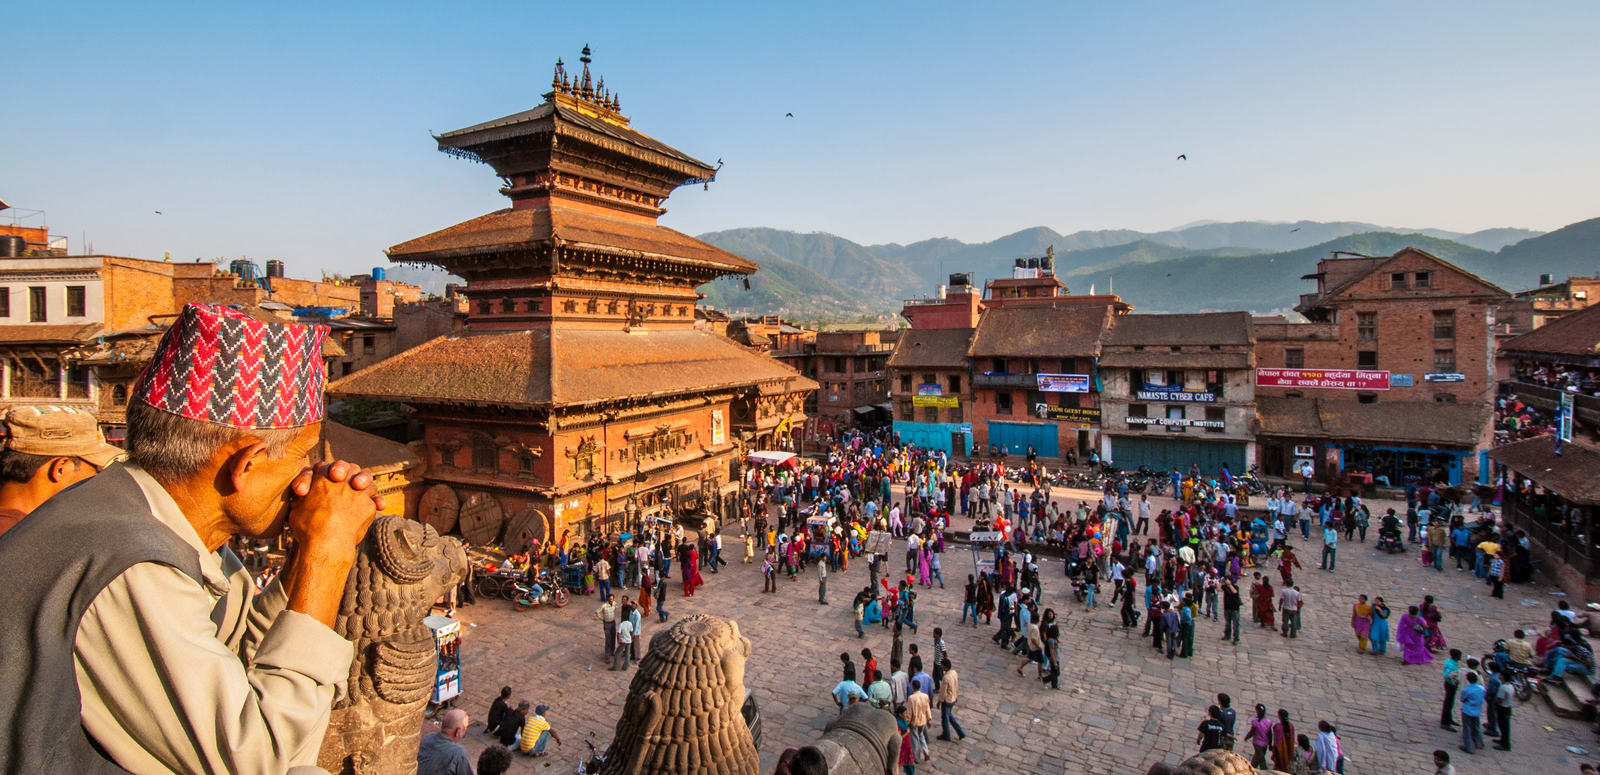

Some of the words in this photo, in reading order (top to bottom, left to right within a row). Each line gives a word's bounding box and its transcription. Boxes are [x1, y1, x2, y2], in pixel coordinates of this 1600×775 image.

[1137, 391, 1169, 400] NAMASTE
[1170, 392, 1193, 401] CYBER
[1194, 393, 1215, 402] CAFE
[1064, 407, 1081, 415] GUEST
[1082, 408, 1101, 416] HOUSE
[1159, 418, 1191, 426] COMPUTER
[1193, 420, 1225, 428] INSTITUTE
